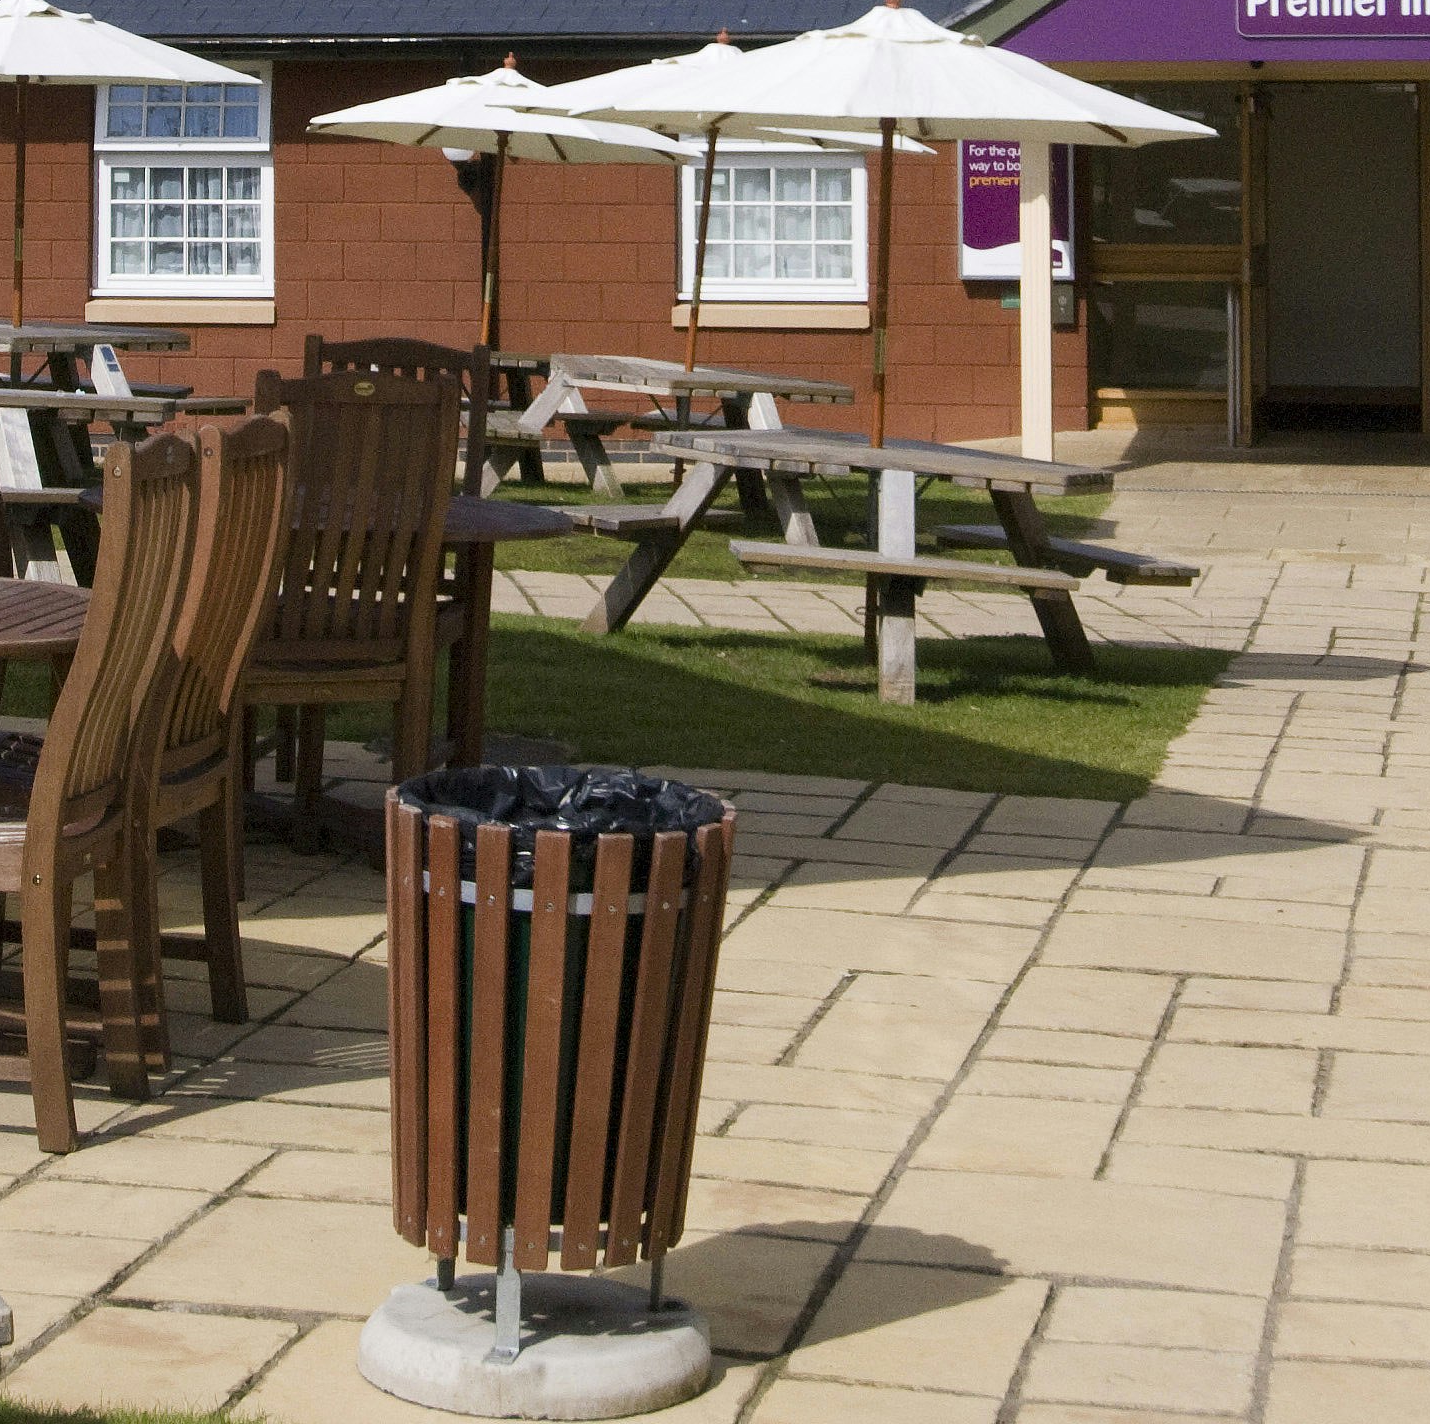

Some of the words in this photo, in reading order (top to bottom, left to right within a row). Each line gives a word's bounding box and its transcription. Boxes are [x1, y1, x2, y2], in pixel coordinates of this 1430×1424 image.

[969, 144, 988, 156] For
[989, 144, 1006, 156] the
[968, 162, 991, 174] way
[992, 160, 1006, 171] to
